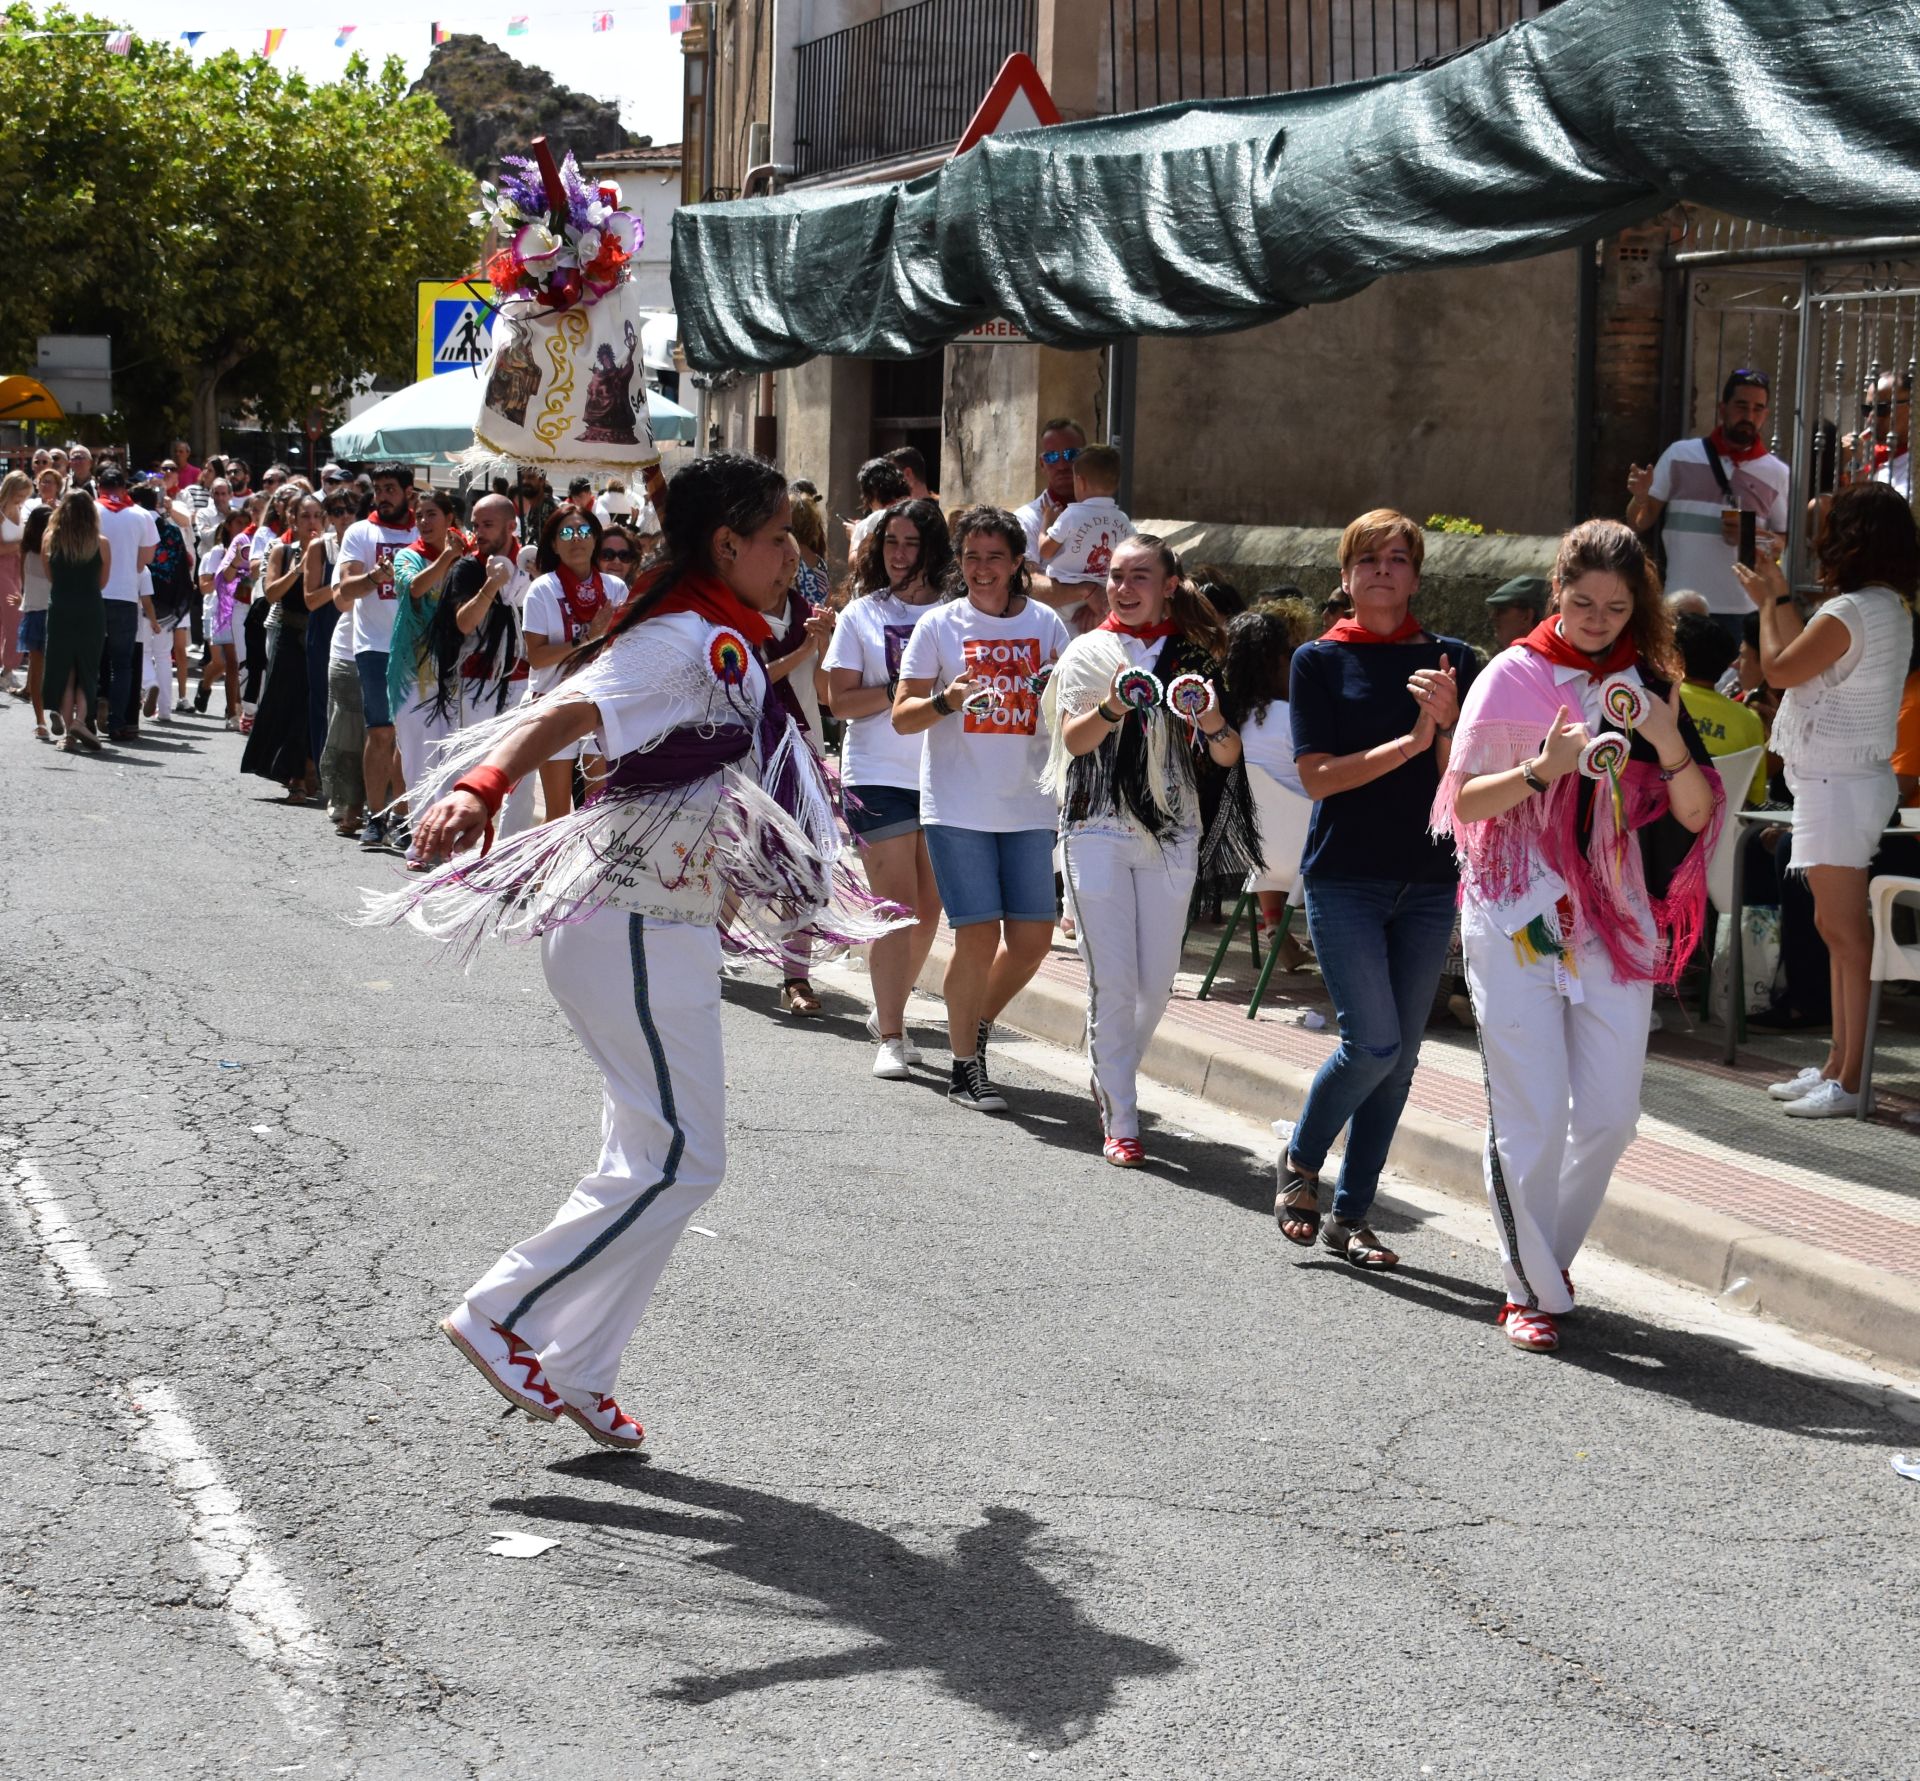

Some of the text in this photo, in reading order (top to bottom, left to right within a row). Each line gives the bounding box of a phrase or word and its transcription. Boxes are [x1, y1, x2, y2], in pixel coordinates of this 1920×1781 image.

[1071, 522, 1092, 554] GAITA
[1093, 516, 1110, 526] DE
[975, 645, 1032, 662] POM
[1694, 717, 1726, 740] ÑA
